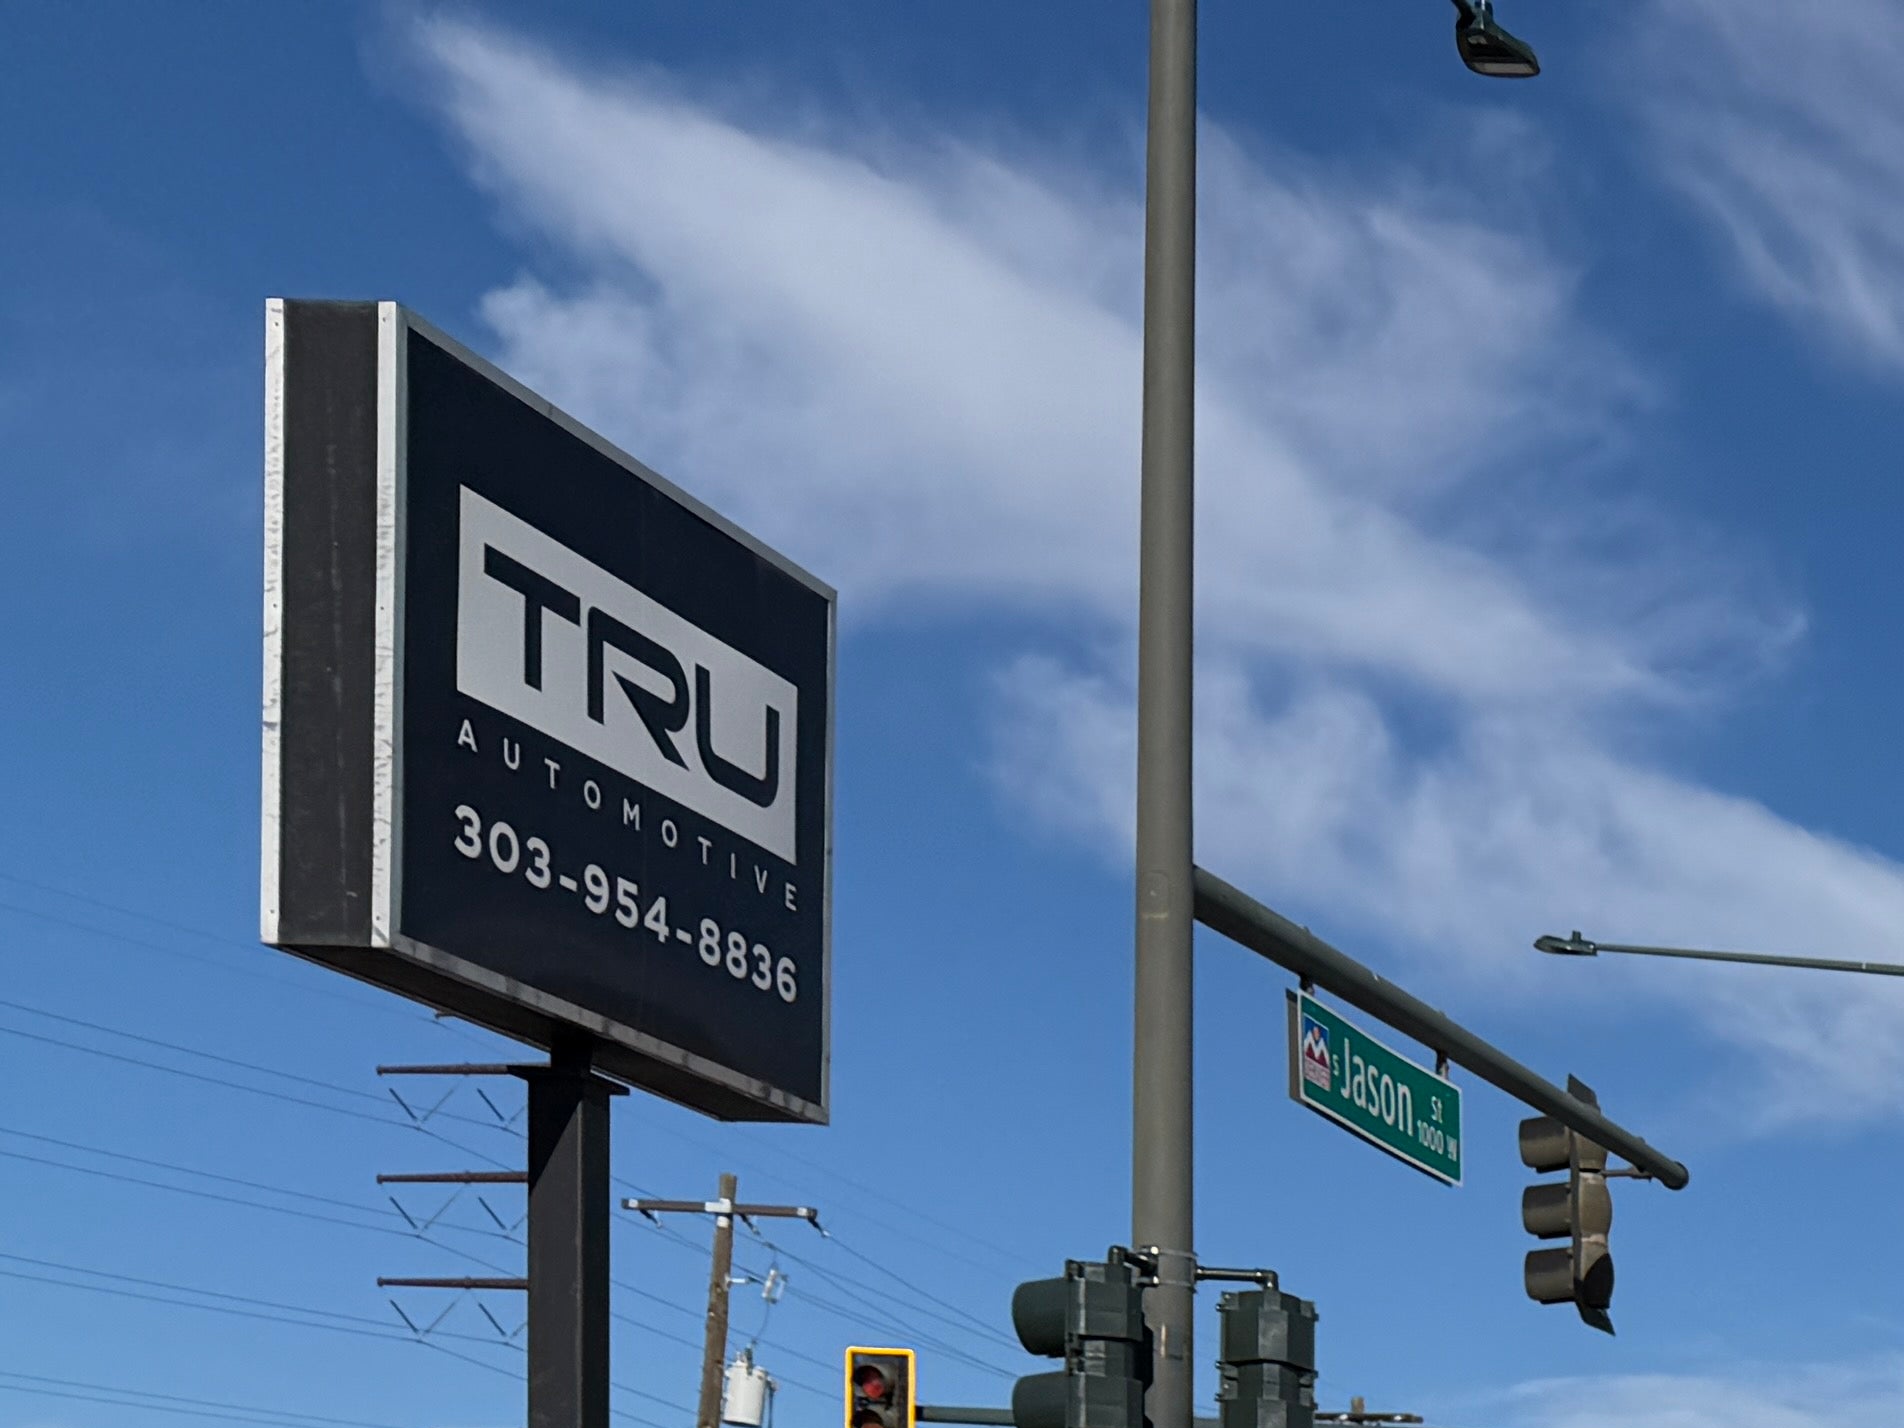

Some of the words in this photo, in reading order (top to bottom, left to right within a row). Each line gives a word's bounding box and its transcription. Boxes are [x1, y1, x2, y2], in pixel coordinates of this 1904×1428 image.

[484, 543, 780, 809] TRU
[454, 805, 798, 1003] 303-954-8836
[457, 719, 798, 911] AUTOMOTIVE
[1333, 1054, 1340, 1077] S
[1341, 1038, 1413, 1137] Jason
[1431, 1095, 1443, 1124] St
[1416, 1119, 1444, 1155] 1000
